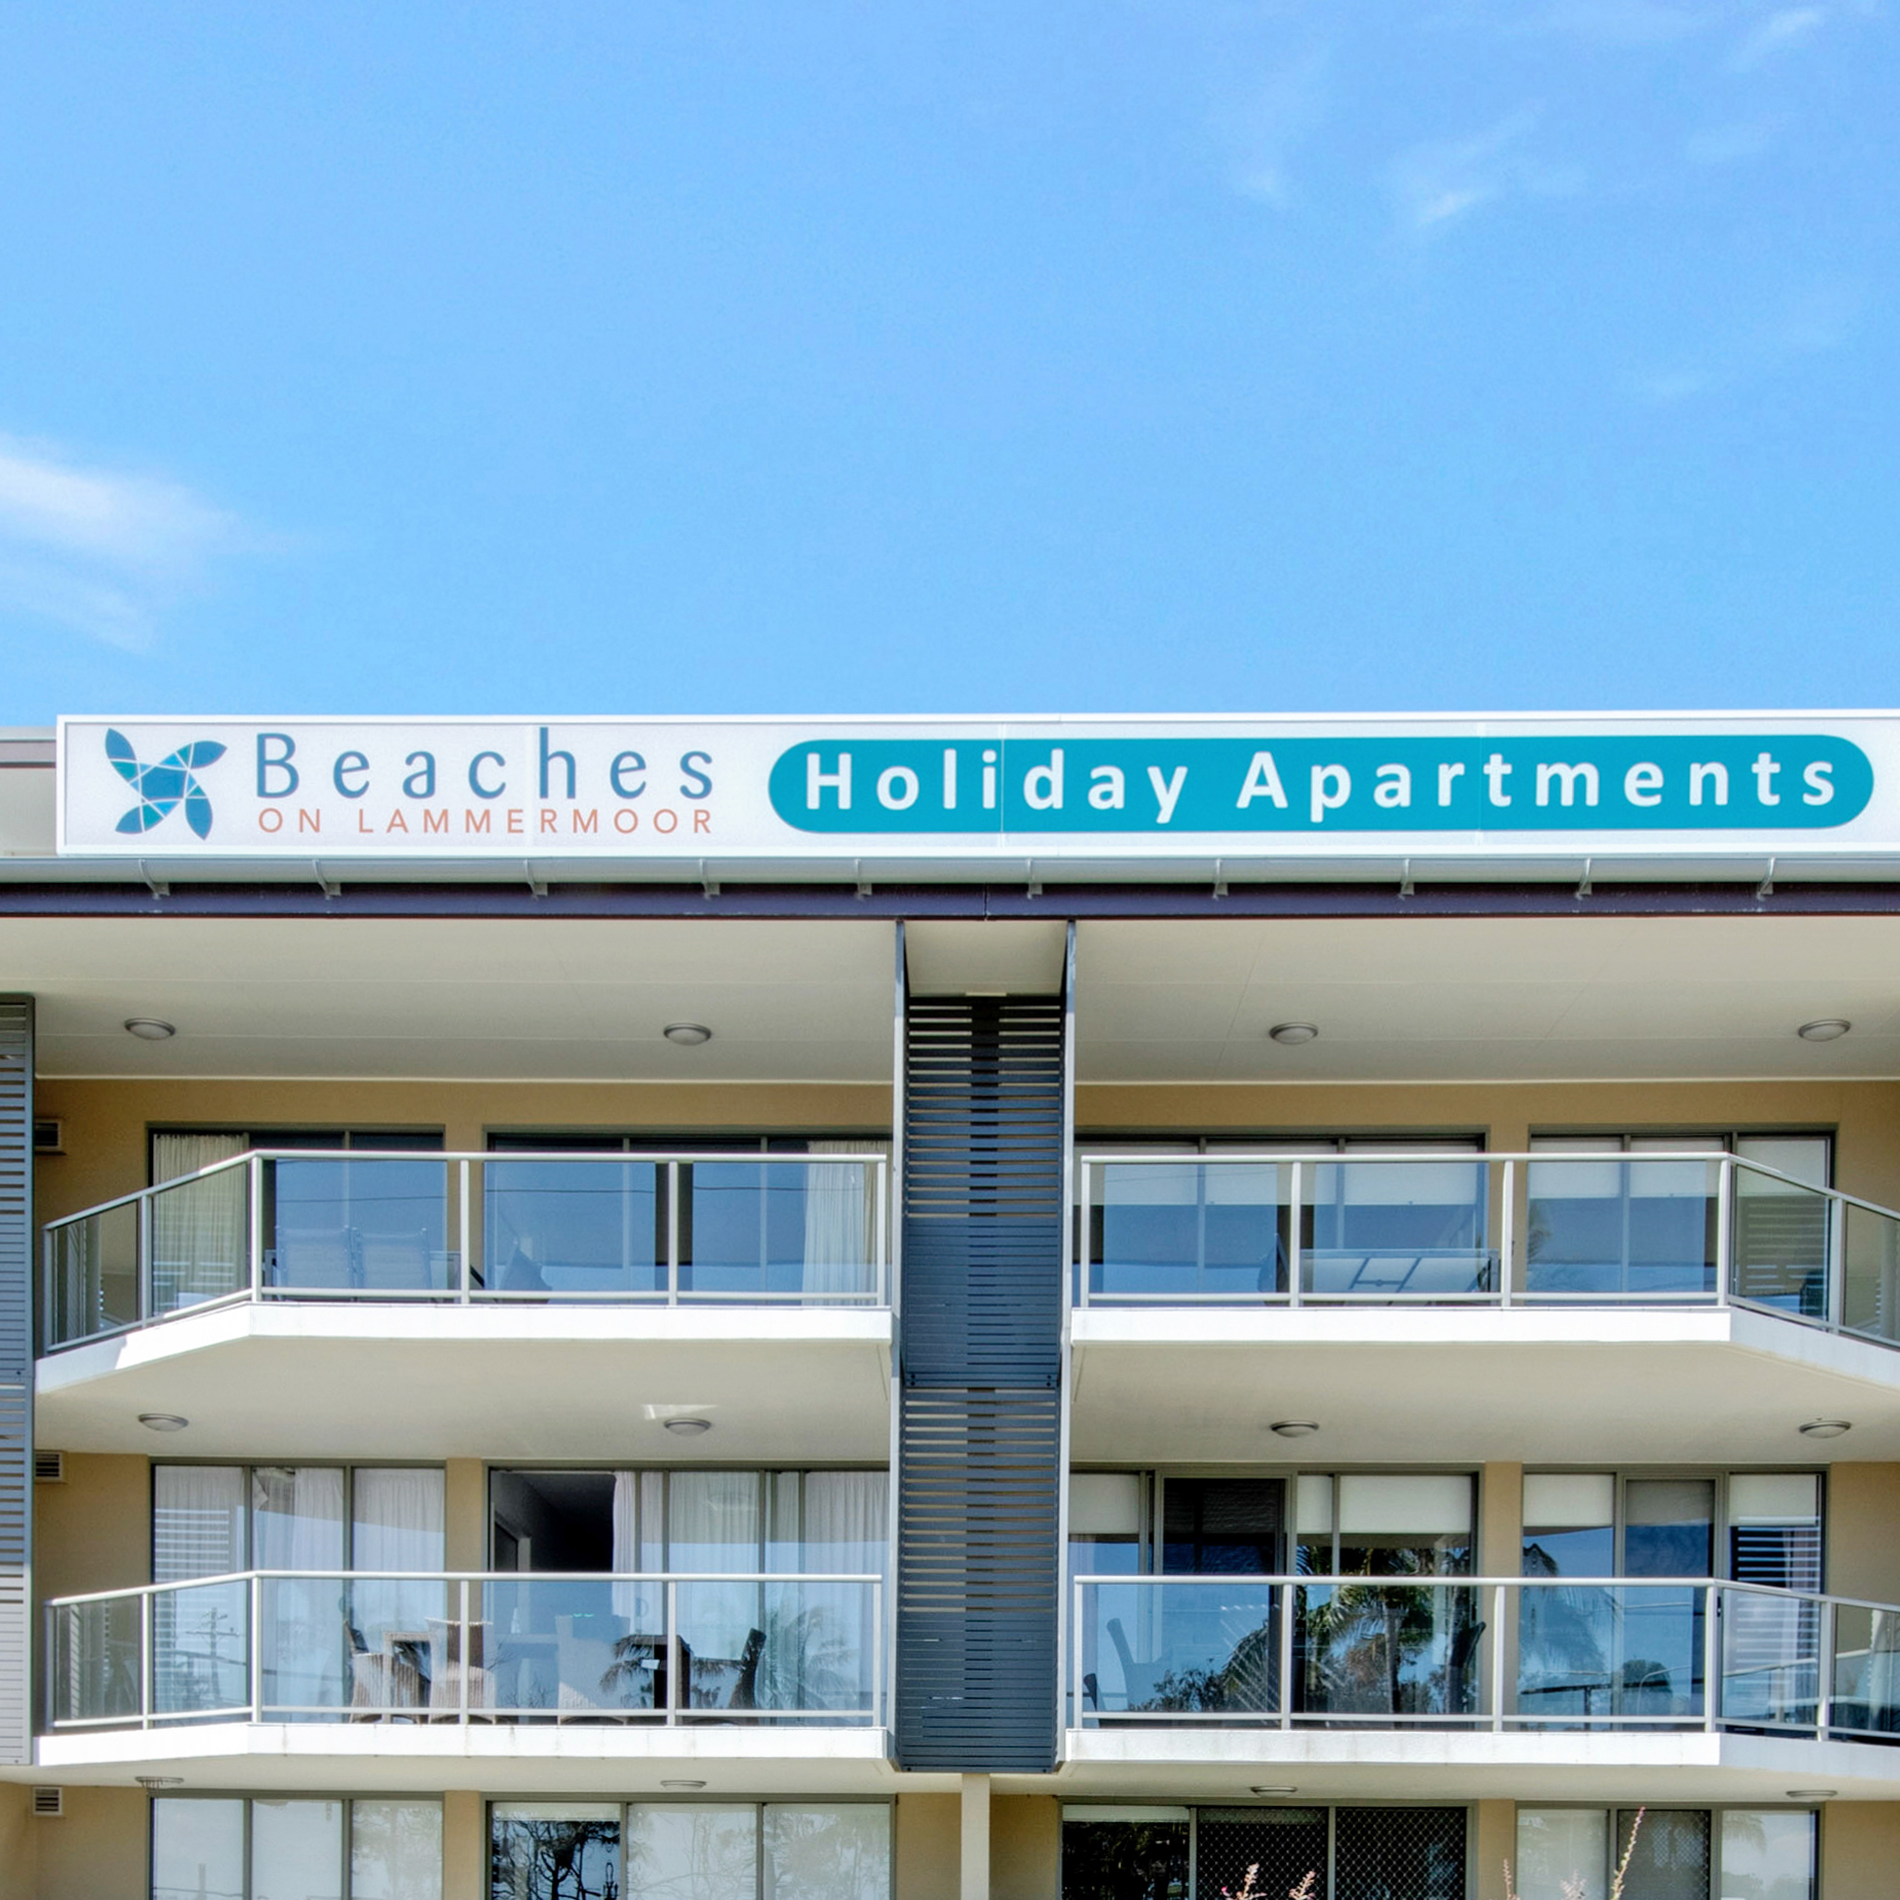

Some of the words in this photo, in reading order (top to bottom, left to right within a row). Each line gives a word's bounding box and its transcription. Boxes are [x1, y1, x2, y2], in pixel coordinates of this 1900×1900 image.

[255, 725, 715, 801] Beaches
[806, 748, 1191, 826] Holiday
[1236, 751, 1837, 825] Apartments
[257, 807, 323, 836] ON
[358, 807, 713, 836] LAMMERMOOR
